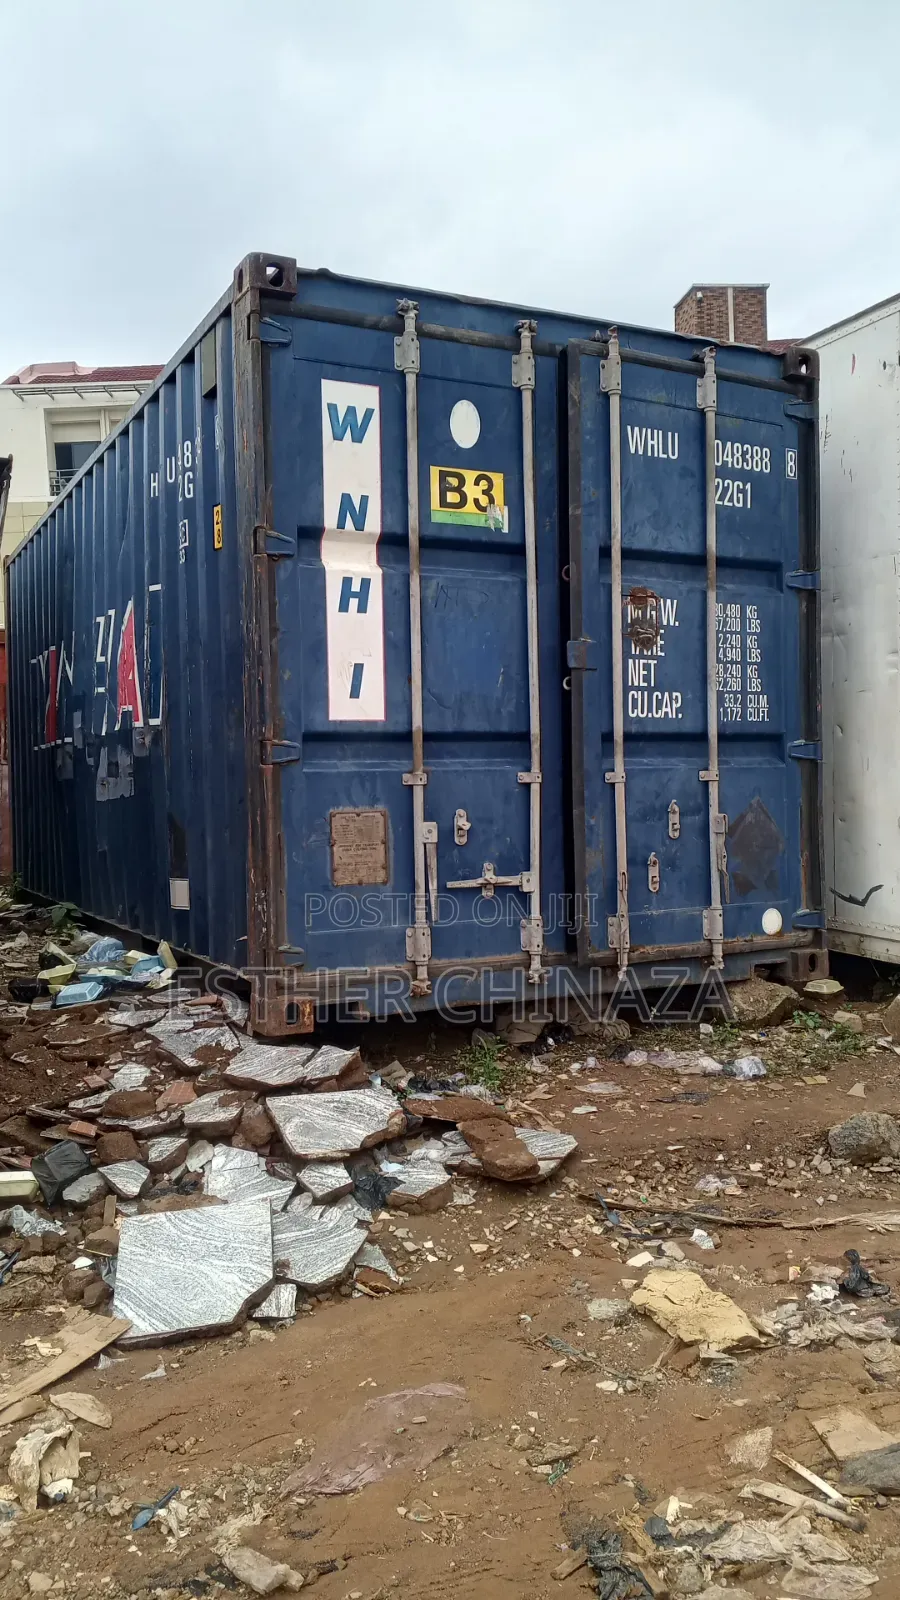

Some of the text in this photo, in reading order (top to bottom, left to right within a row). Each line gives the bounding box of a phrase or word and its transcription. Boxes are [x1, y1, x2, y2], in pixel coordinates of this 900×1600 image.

[627, 425, 796, 477] WHLU 048388 8
[438, 469, 496, 513] B3
[714, 478, 751, 509] 22G1
[746, 605, 757, 619] KG
[746, 619, 761, 633] LBS
[718, 633, 758, 649] 2,240 KG
[718, 647, 761, 663] 4,940 LBS
[628, 658, 658, 687] NET
[747, 664, 758, 678] KG
[747, 678, 762, 692] LBS
[628, 690, 769, 719] CU.CAP. 33.2 CU.M.
[720, 707, 742, 722] 1,172
